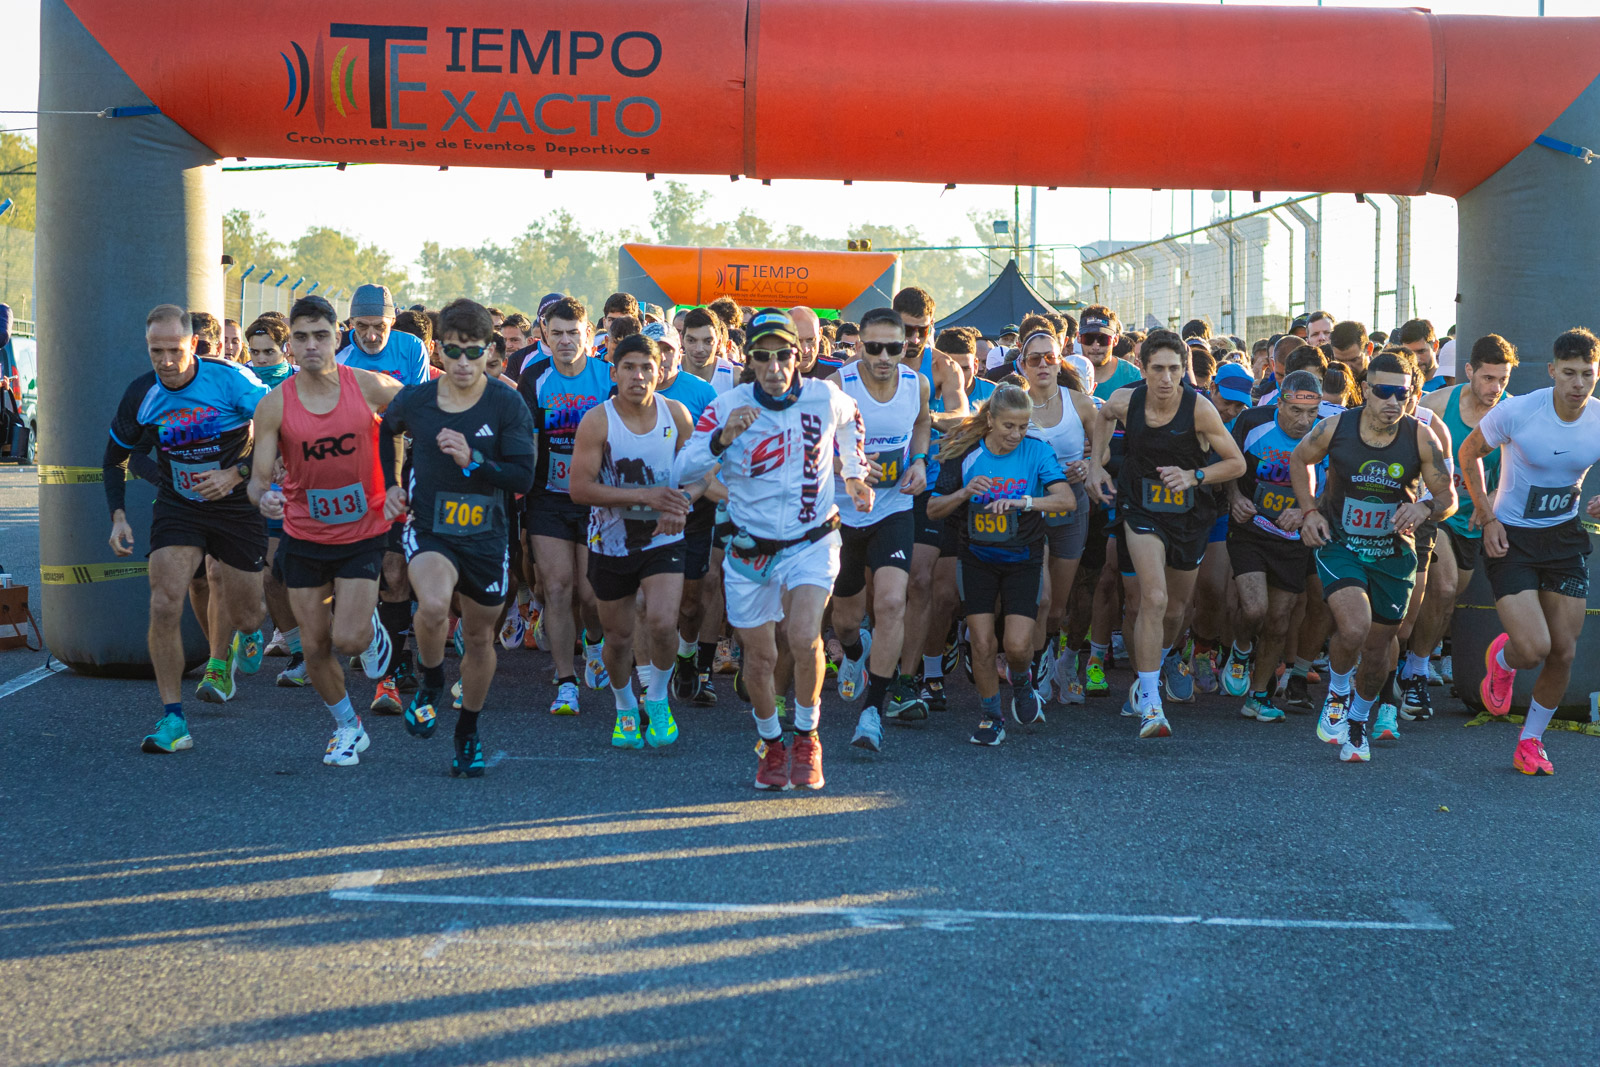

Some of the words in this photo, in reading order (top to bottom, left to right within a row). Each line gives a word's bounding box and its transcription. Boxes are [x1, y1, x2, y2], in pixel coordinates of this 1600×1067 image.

[286, 132, 426, 151] Cronometraje
[435, 139, 457, 148] de
[463, 139, 536, 152] Eventos
[546, 142, 650, 156] Deportivos
[302, 433, 356, 461] KRC
[863, 434, 908, 446] UNNEA
[1392, 465, 1400, 477] 3
[1351, 475, 1402, 489] EGUSQUIZA
[318, 494, 356, 517] 313
[1151, 484, 1184, 506] 718
[1263, 491, 1295, 512] 637
[1538, 493, 1571, 512] 106
[445, 500, 484, 527] 706
[975, 513, 1007, 533] 650
[1351, 508, 1386, 529] 317
